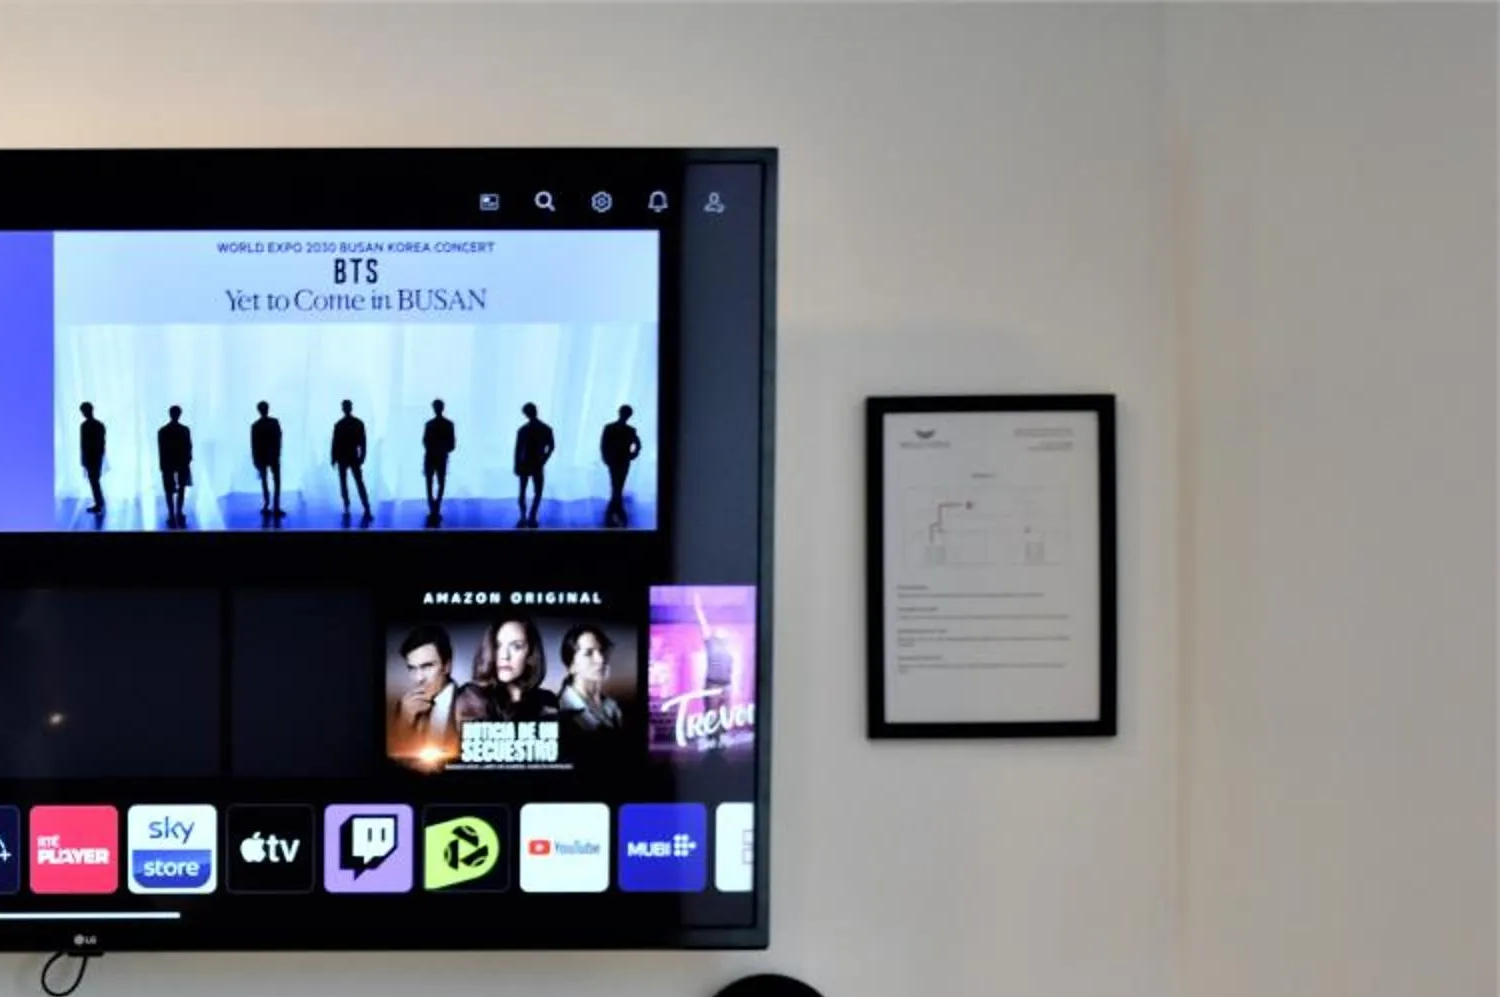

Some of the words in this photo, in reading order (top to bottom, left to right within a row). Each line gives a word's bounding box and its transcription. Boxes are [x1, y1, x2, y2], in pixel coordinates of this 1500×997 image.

[216, 242, 265, 254] WORLD
[268, 242, 301, 254] EXPO
[306, 242, 337, 254] 2030
[340, 241, 384, 254] BUSAN
[388, 241, 431, 253] KOREA
[434, 241, 495, 253] CONCERT
[334, 258, 380, 284] BTS
[225, 288, 261, 312] Yet
[267, 291, 290, 312] to
[294, 288, 366, 312] Come
[371, 288, 392, 311] in
[397, 287, 487, 311] BUSAN
[423, 591, 501, 605] AMAZON
[510, 591, 602, 604] ORIGINAL
[148, 815, 195, 844] sky
[37, 848, 110, 864] PLAYER
[554, 840, 601, 856] YouTube
[627, 841, 671, 857] MUBI
[143, 861, 199, 877] store
